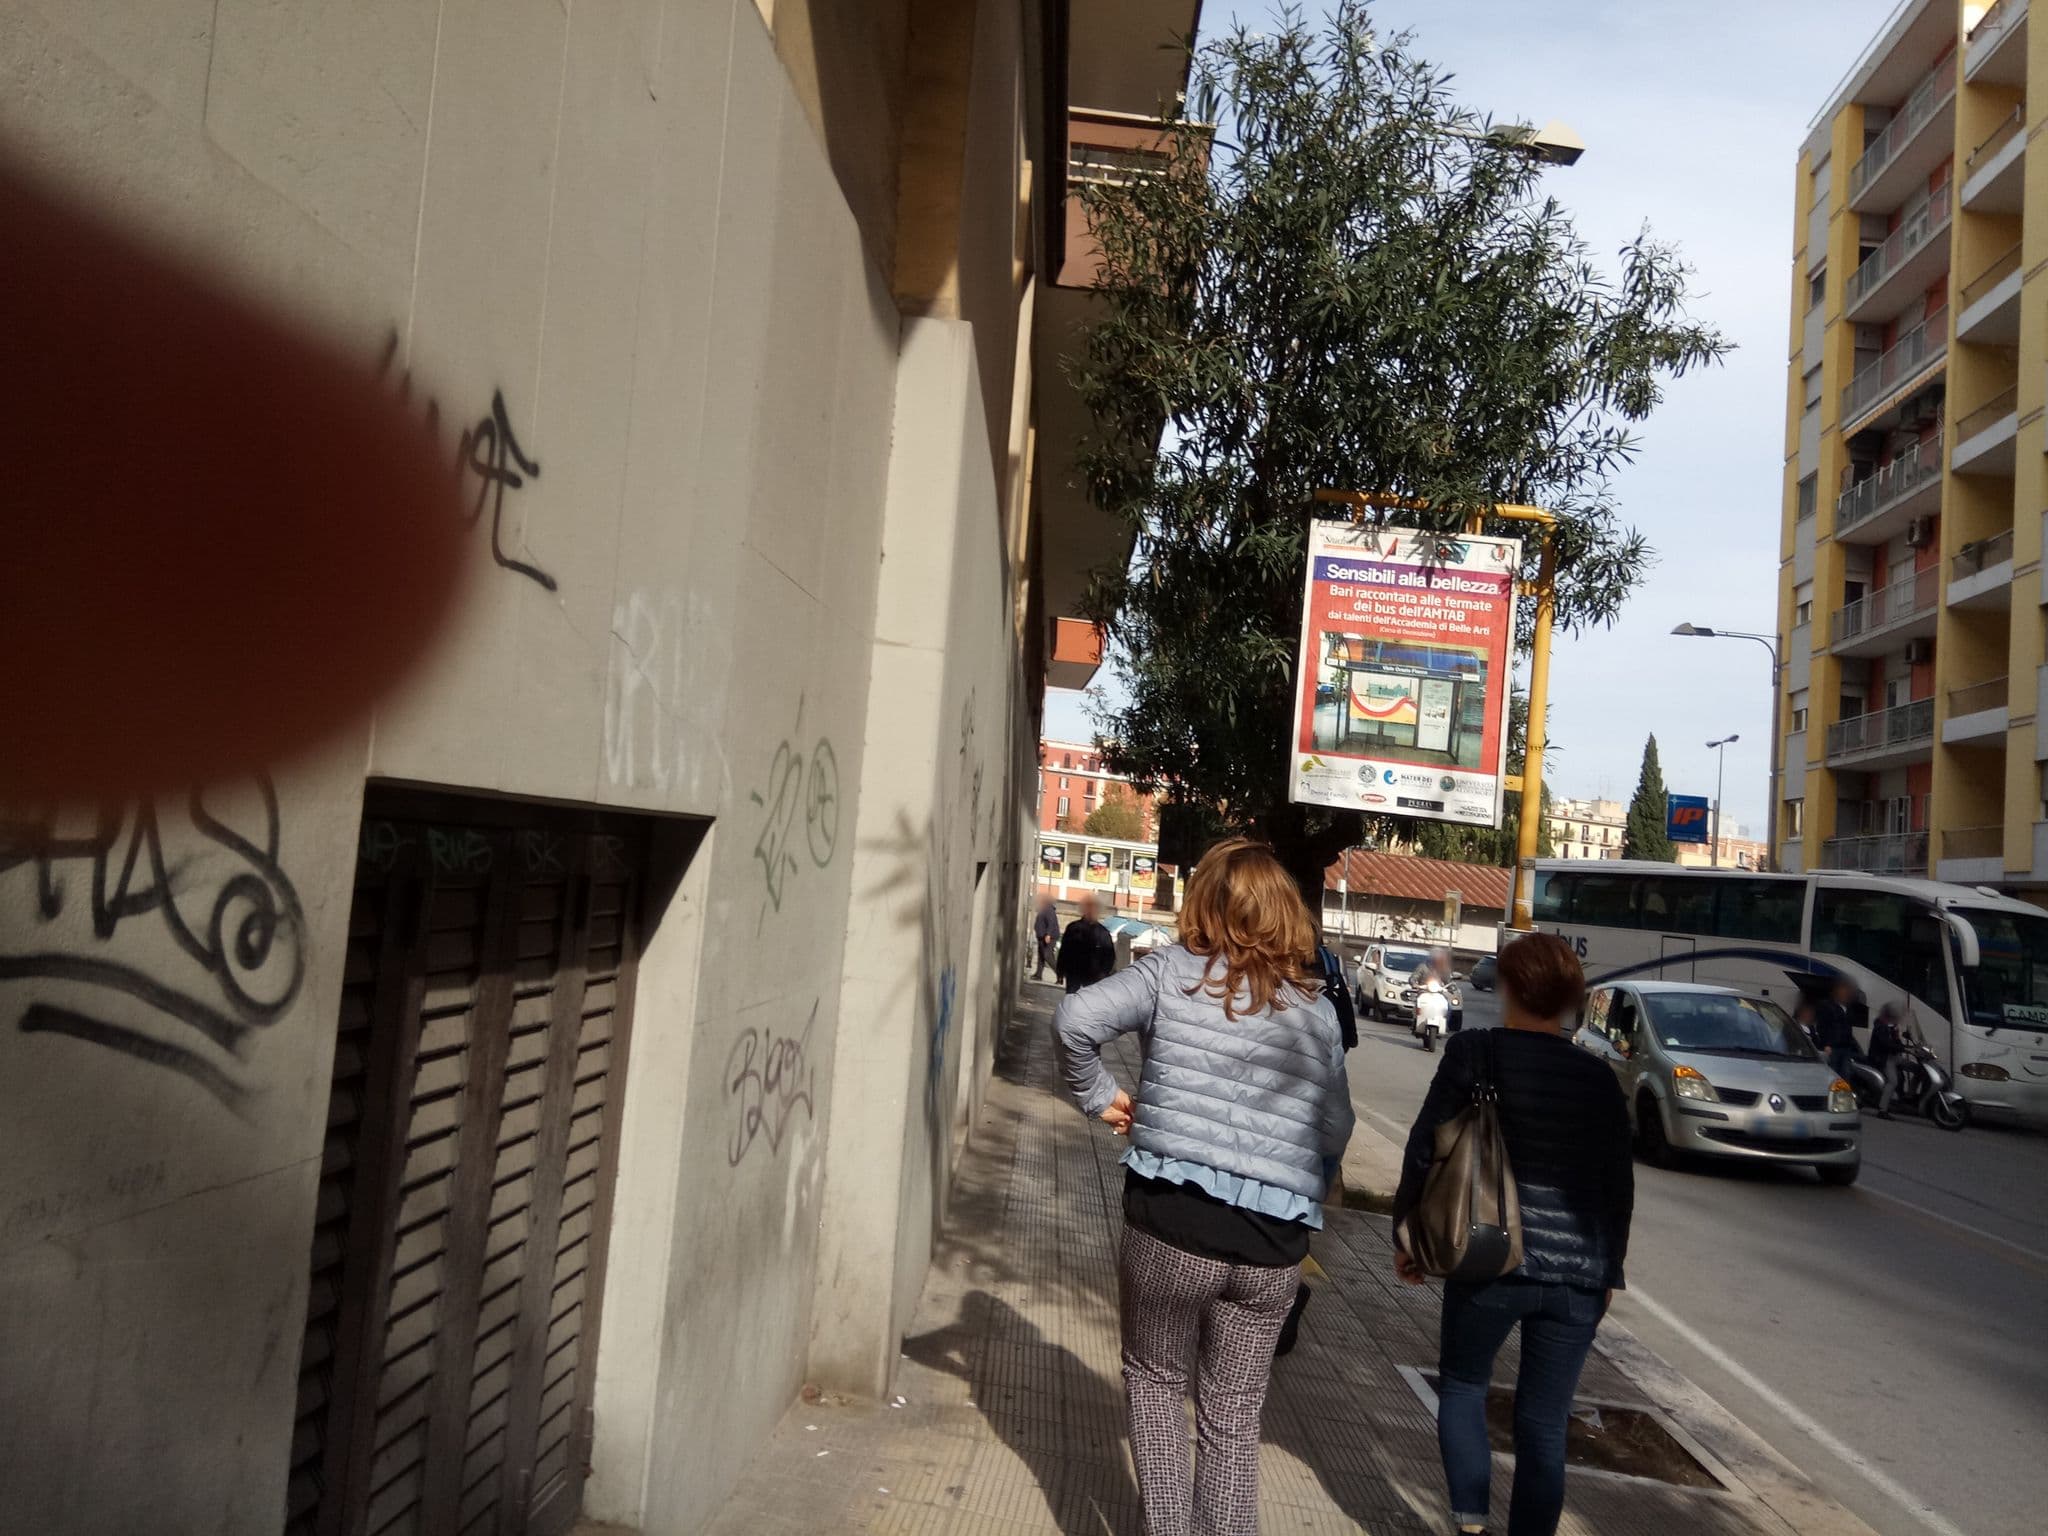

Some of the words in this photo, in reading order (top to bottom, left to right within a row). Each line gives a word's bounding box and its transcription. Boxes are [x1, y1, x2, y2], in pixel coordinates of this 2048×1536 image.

[1327, 564, 1396, 585] Sensibili
[1330, 584, 1354, 598] Bari
[1356, 588, 1418, 604] raccontata
[1420, 593, 1442, 607] alle
[1445, 595, 1493, 611] fermate
[1353, 599, 1373, 612] dei
[1374, 601, 1397, 615] bus
[1398, 604, 1466, 622] dell'AMTAB
[1328, 610, 1342, 619] dai
[1343, 611, 1372, 623] talenti
[1373, 615, 1437, 630] dell'Accademia
[1438, 621, 1448, 631] di
[1449, 622, 1472, 633] Belle
[1472, 625, 1490, 636] Arti
[1671, 807, 1704, 825] IP
